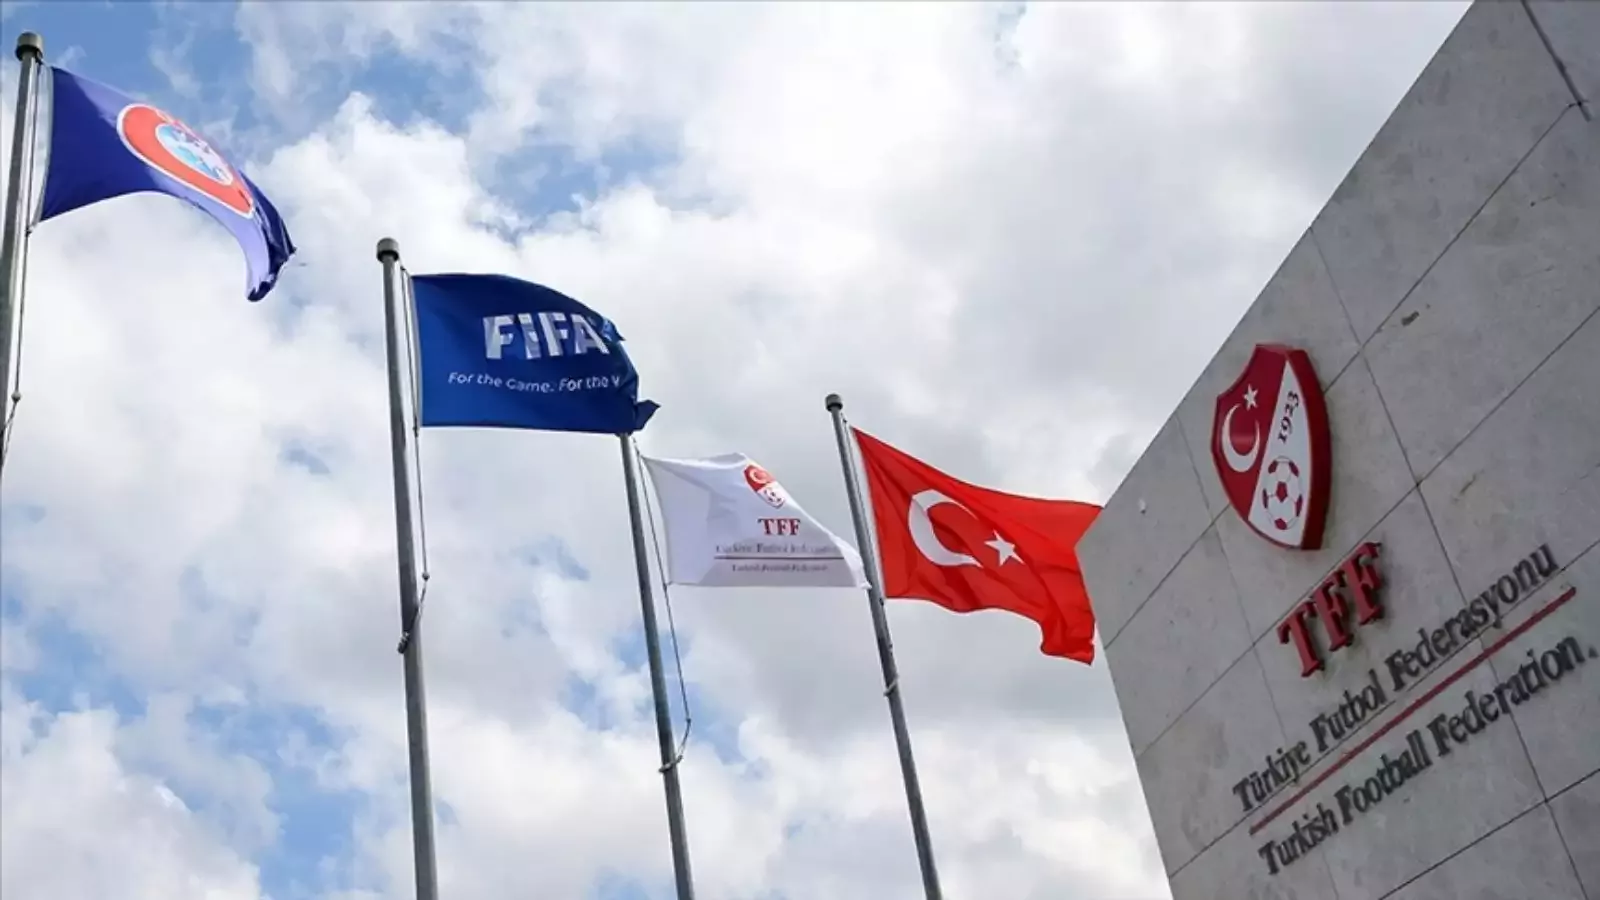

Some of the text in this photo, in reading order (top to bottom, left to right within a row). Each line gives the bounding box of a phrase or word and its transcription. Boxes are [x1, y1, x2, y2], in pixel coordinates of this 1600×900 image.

[483, 312, 610, 360] FIFA
[448, 372, 474, 384] For
[477, 373, 502, 388] the
[506, 378, 555, 394] Game.
[559, 378, 583, 392] For
[586, 375, 609, 389] the
[1277, 391, 1300, 444] 1923
[758, 518, 801, 535] TFF
[1277, 542, 1383, 677] TFF
[1233, 543, 1559, 812] Türkiye Futbol Federasyonu
[1258, 802, 1340, 875] Turkish
[1334, 729, 1433, 825] Football
